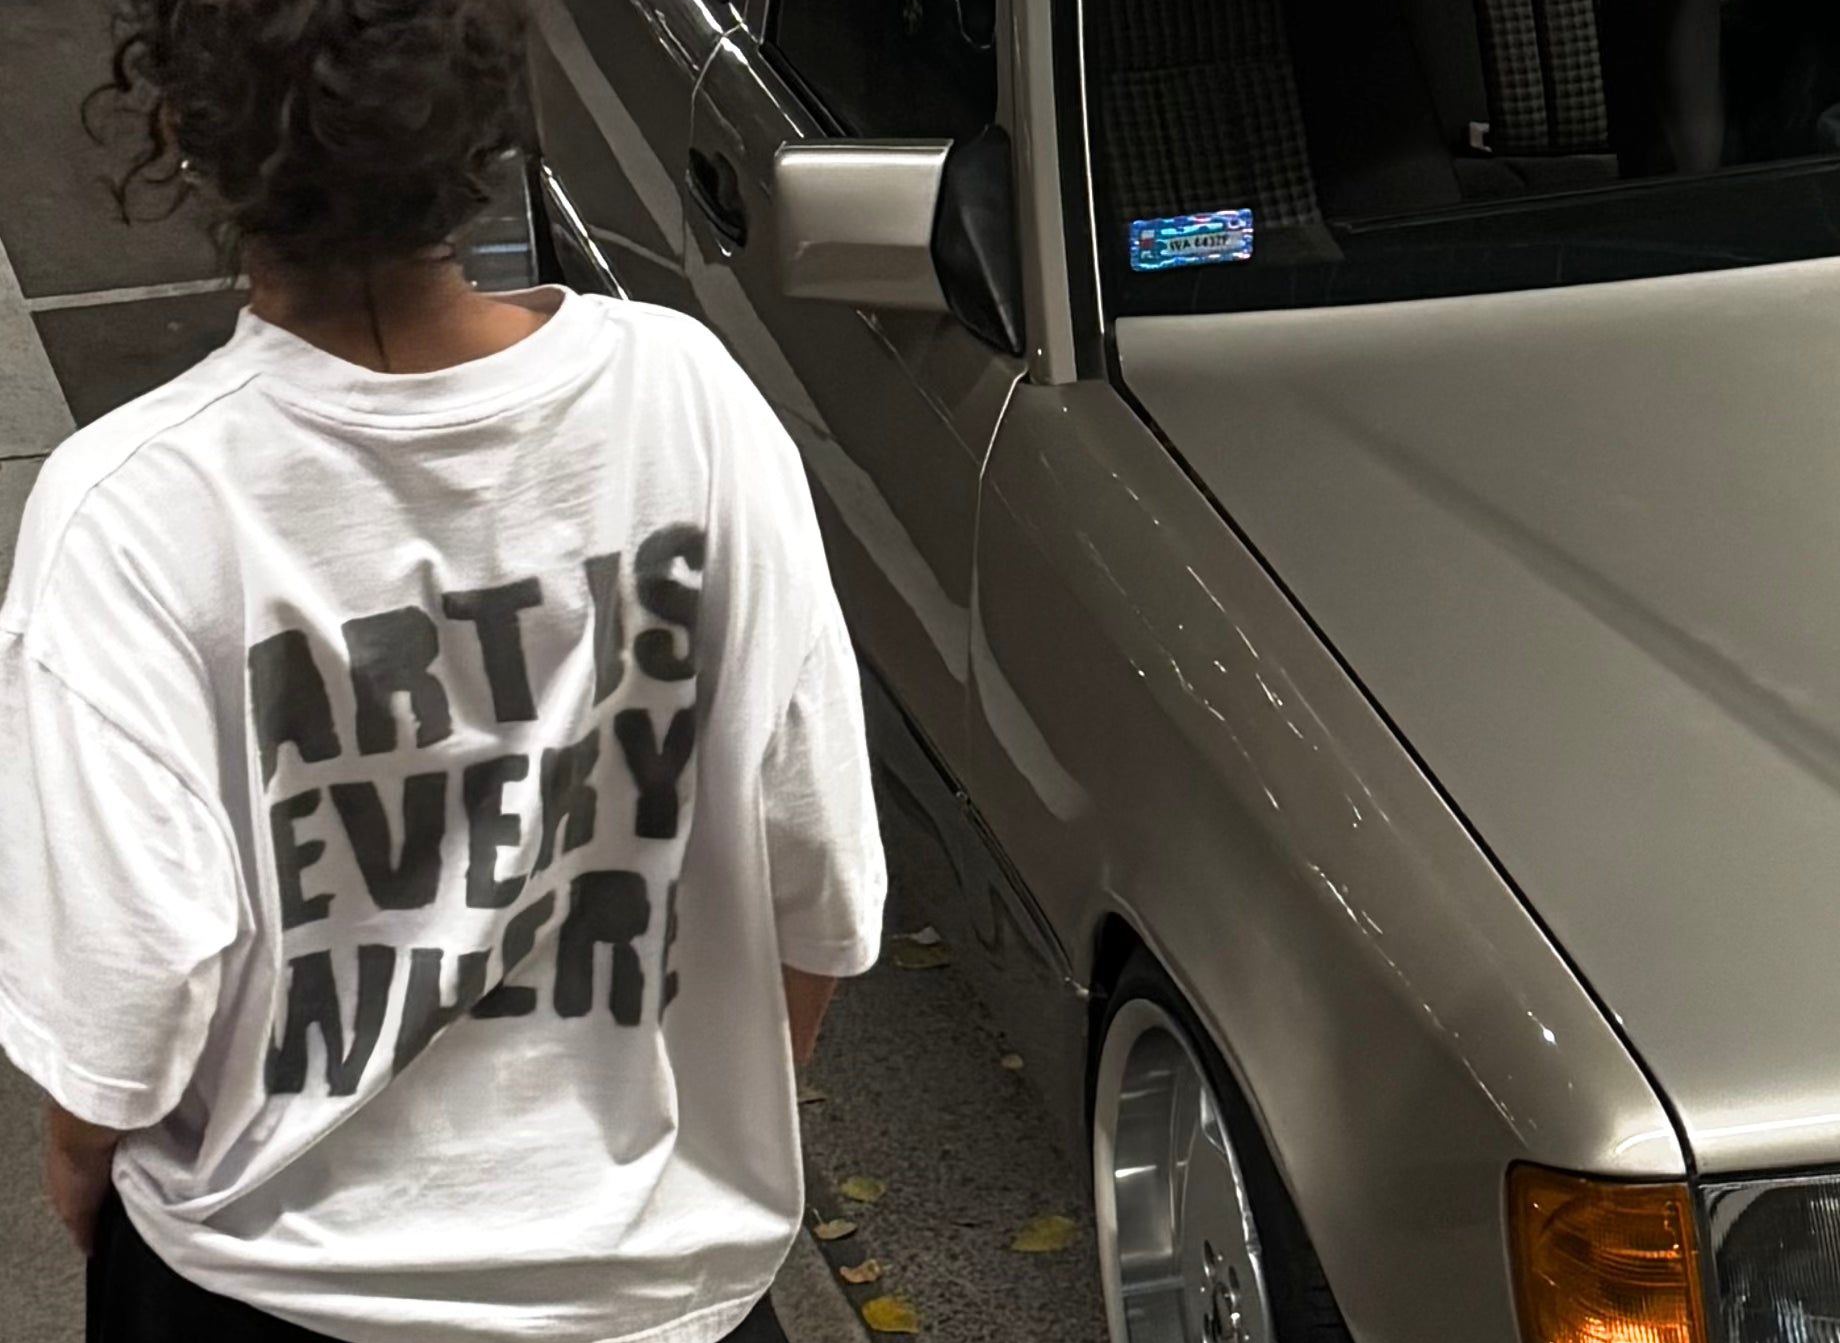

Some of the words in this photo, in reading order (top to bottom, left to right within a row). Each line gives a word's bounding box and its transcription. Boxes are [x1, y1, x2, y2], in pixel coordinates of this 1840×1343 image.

[249, 577, 542, 794] ART
[583, 522, 708, 712] IS
[268, 708, 698, 932] EVERY
